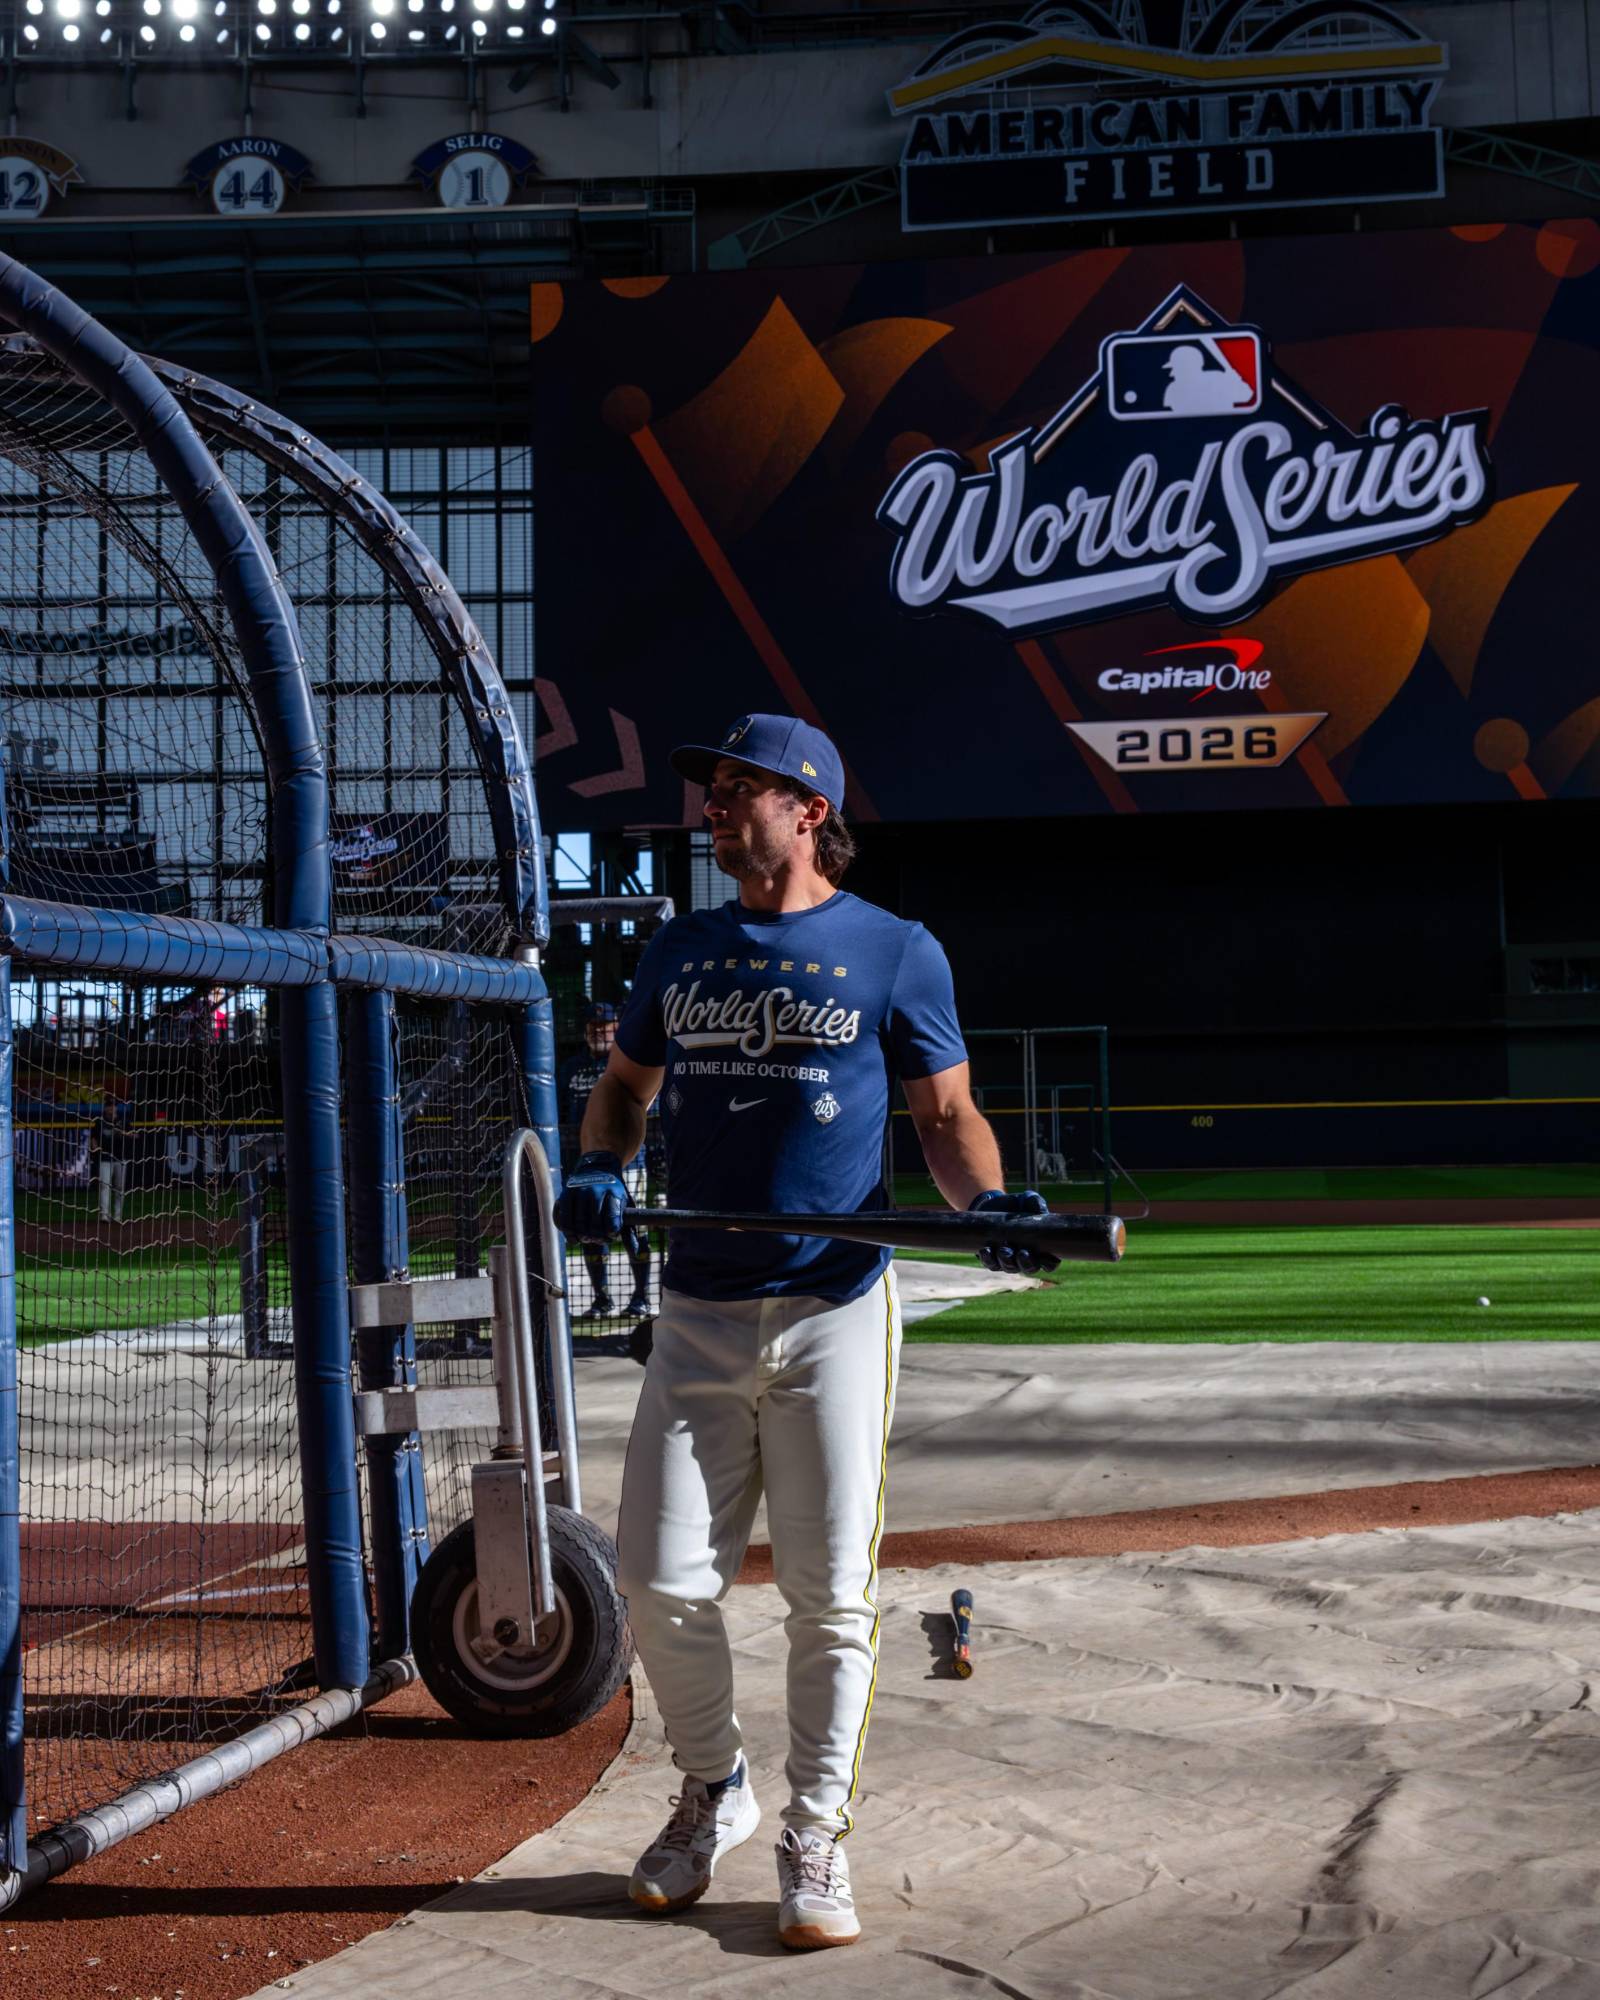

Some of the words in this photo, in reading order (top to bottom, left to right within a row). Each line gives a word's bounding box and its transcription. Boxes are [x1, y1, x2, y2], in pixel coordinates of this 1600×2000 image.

[907, 97, 1202, 160] AMERICAN
[1228, 82, 1433, 138] FAMILY
[218, 139, 282, 160] AARON
[444, 134, 504, 153] SELIG
[219, 169, 278, 209] 44
[464, 167, 488, 205] 1
[1063, 147, 1275, 205] FIELD
[887, 440, 1223, 607] World
[1171, 420, 1488, 615] Series
[1116, 726, 1278, 764] 2026
[681, 958, 848, 978] BREWERS
[662, 980, 769, 1040] World
[739, 986, 862, 1058] Series
[673, 1061, 686, 1075] NO
[688, 1061, 721, 1075] TIME
[722, 1061, 756, 1076] LIKE
[757, 1063, 829, 1083] OCTOBER
[814, 1099, 837, 1118] WS
[1190, 1115, 1214, 1128] 400
